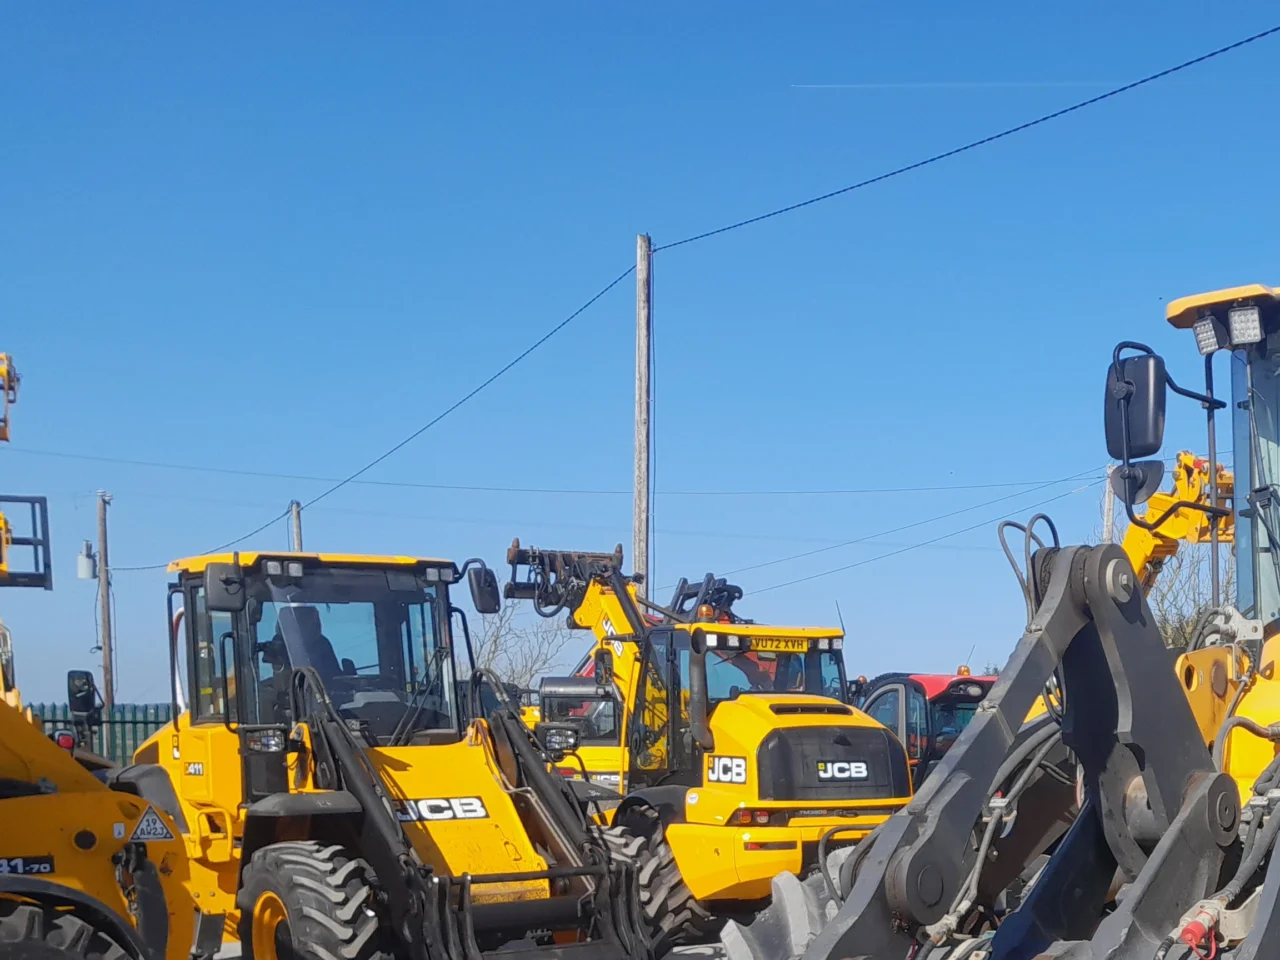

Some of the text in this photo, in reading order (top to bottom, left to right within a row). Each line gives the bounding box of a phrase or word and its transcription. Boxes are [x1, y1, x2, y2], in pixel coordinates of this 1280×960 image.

[755, 637, 804, 650] VU72 XVH
[708, 757, 747, 783] JCB
[818, 762, 868, 778] JCB
[396, 798, 487, 821] JCB
[145, 818, 158, 828] 19
